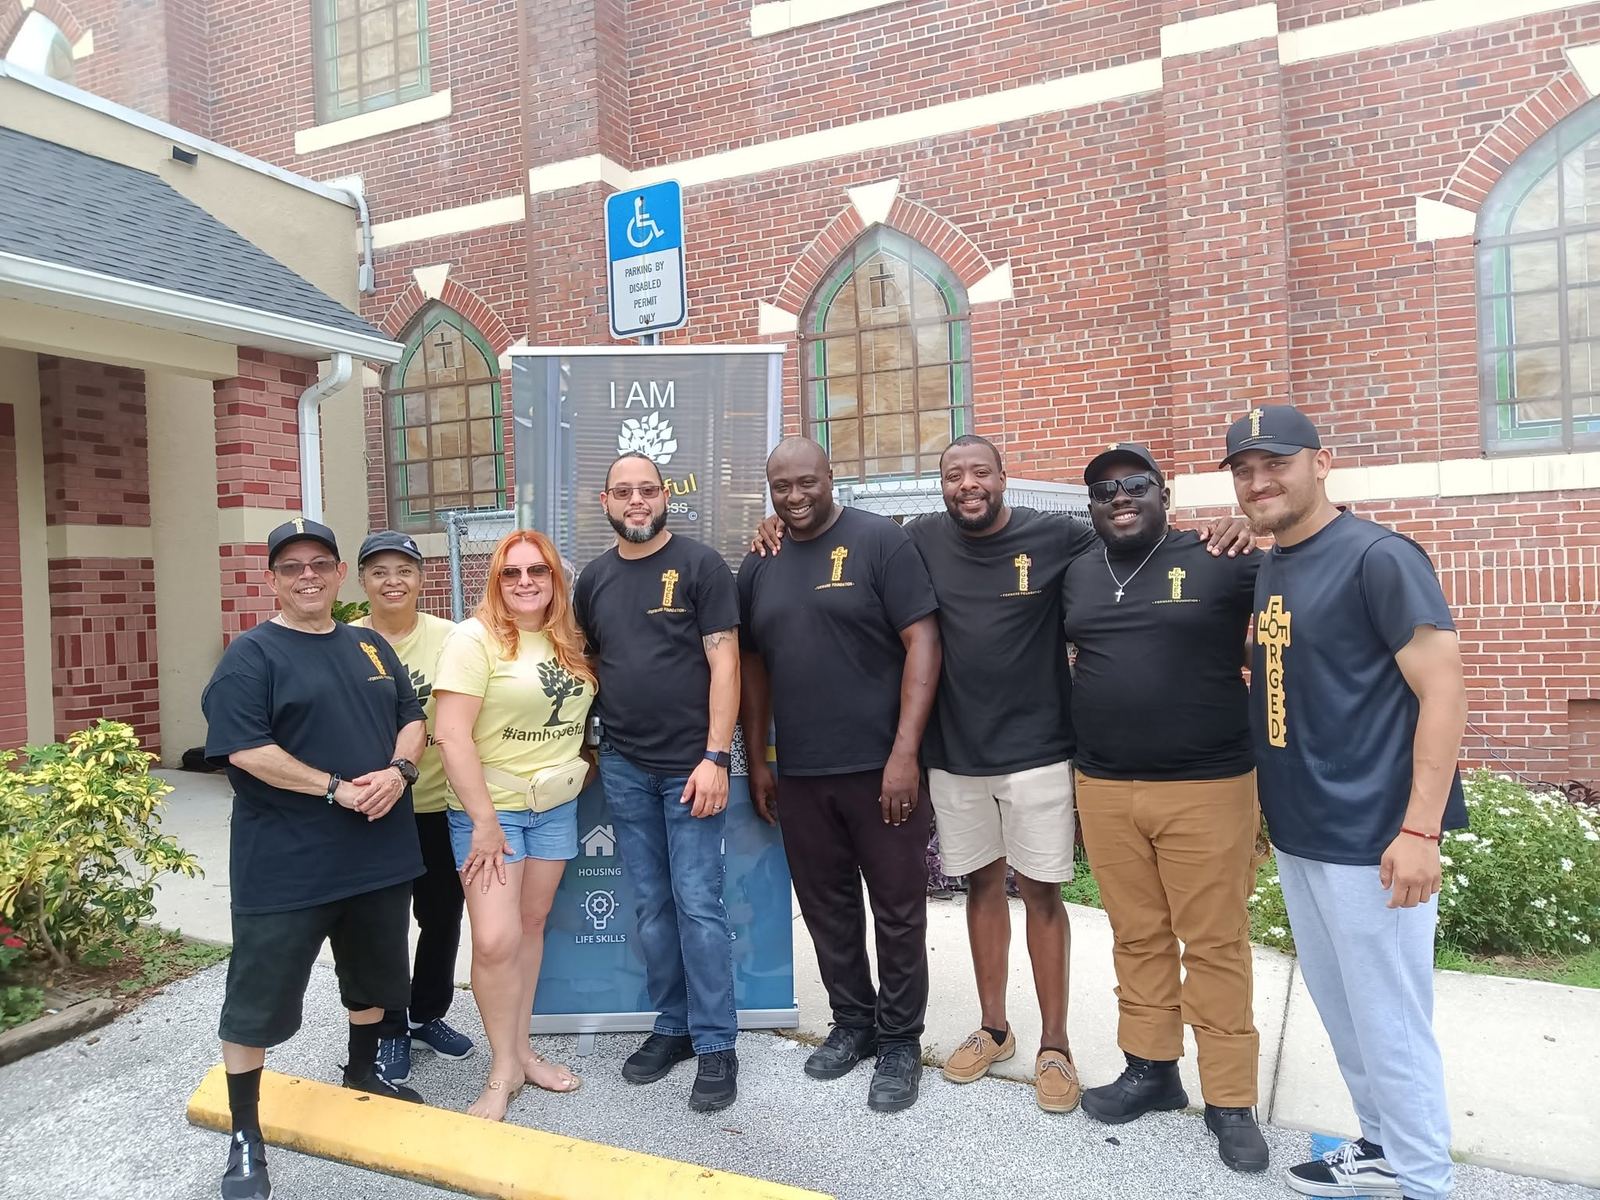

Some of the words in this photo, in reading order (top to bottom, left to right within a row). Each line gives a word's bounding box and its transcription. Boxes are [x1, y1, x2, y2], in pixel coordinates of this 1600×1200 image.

[624, 263, 652, 277] PARKING
[655, 261, 664, 271] BY
[629, 279, 661, 293] DISABLED
[634, 296, 657, 308] PERMIT
[639, 313, 655, 325] ONLY
[610, 381, 615, 408] I
[625, 381, 674, 408] AM
[578, 867, 622, 876] HOUSING
[575, 935, 594, 944] LIFE
[595, 934, 626, 943] SKILLS
